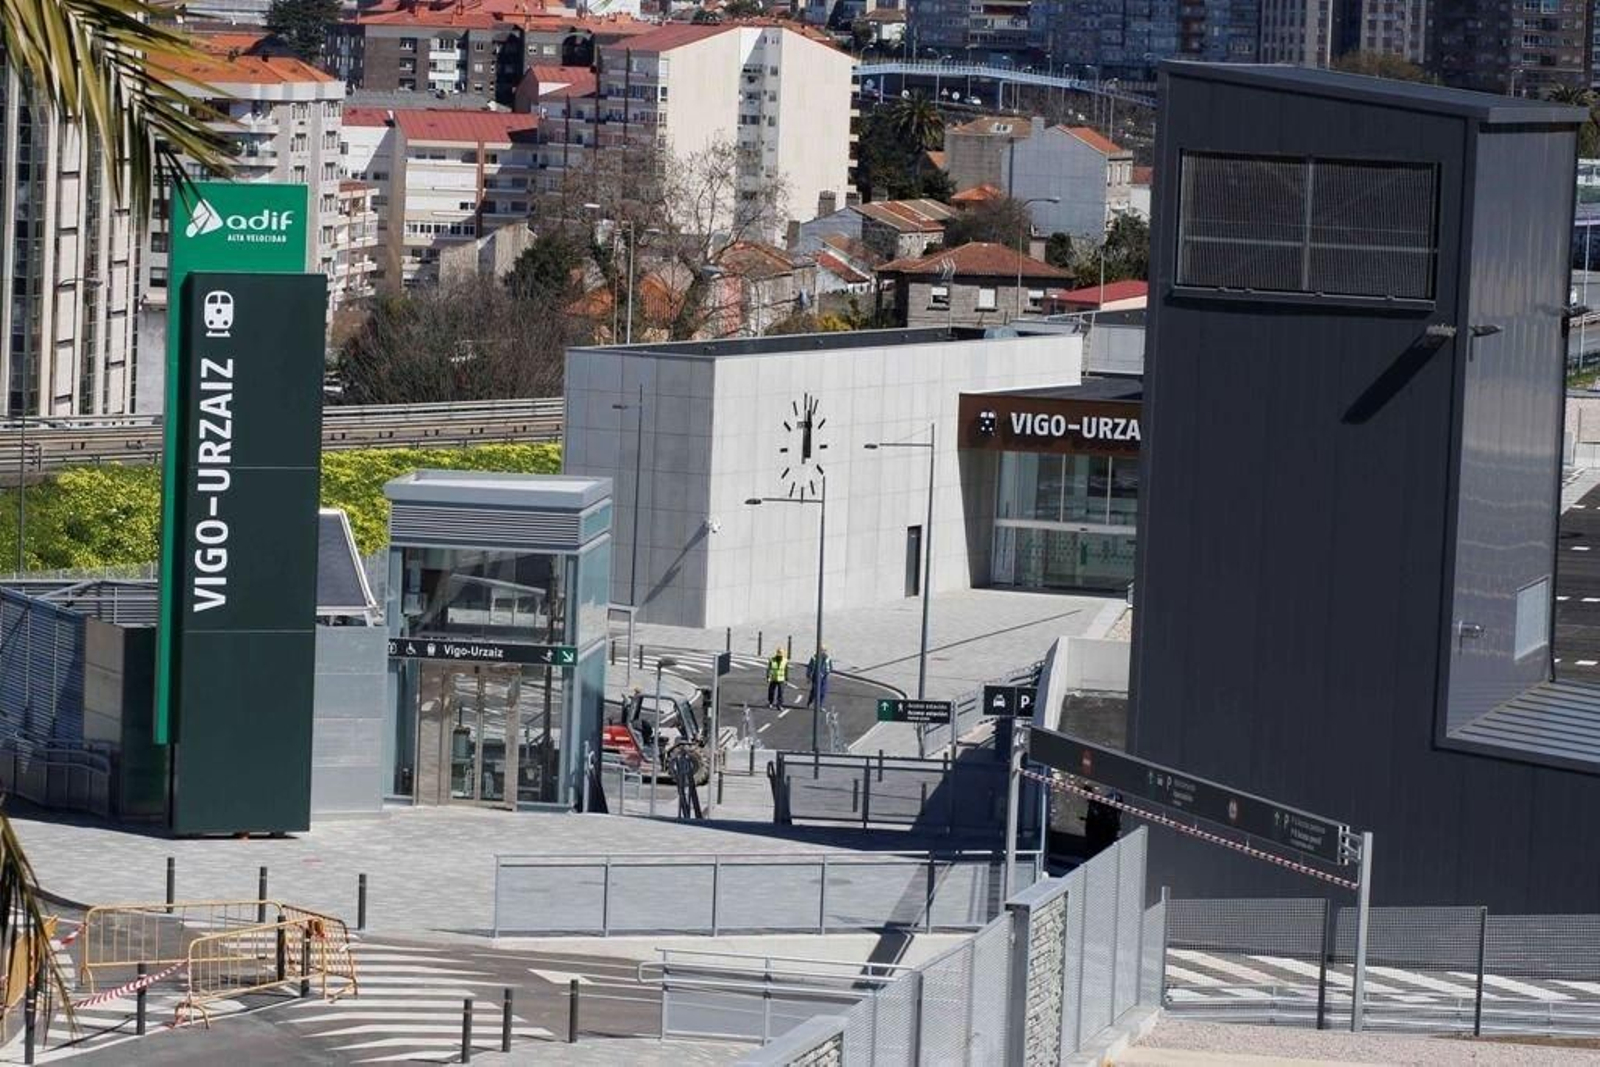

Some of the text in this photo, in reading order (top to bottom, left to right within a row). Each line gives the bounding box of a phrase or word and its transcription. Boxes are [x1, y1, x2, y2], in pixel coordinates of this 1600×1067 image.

[226, 209, 295, 231] adif
[193, 358, 234, 612] VIGO-URZAIZ
[443, 645, 504, 658] Vigo-Urzaiz
